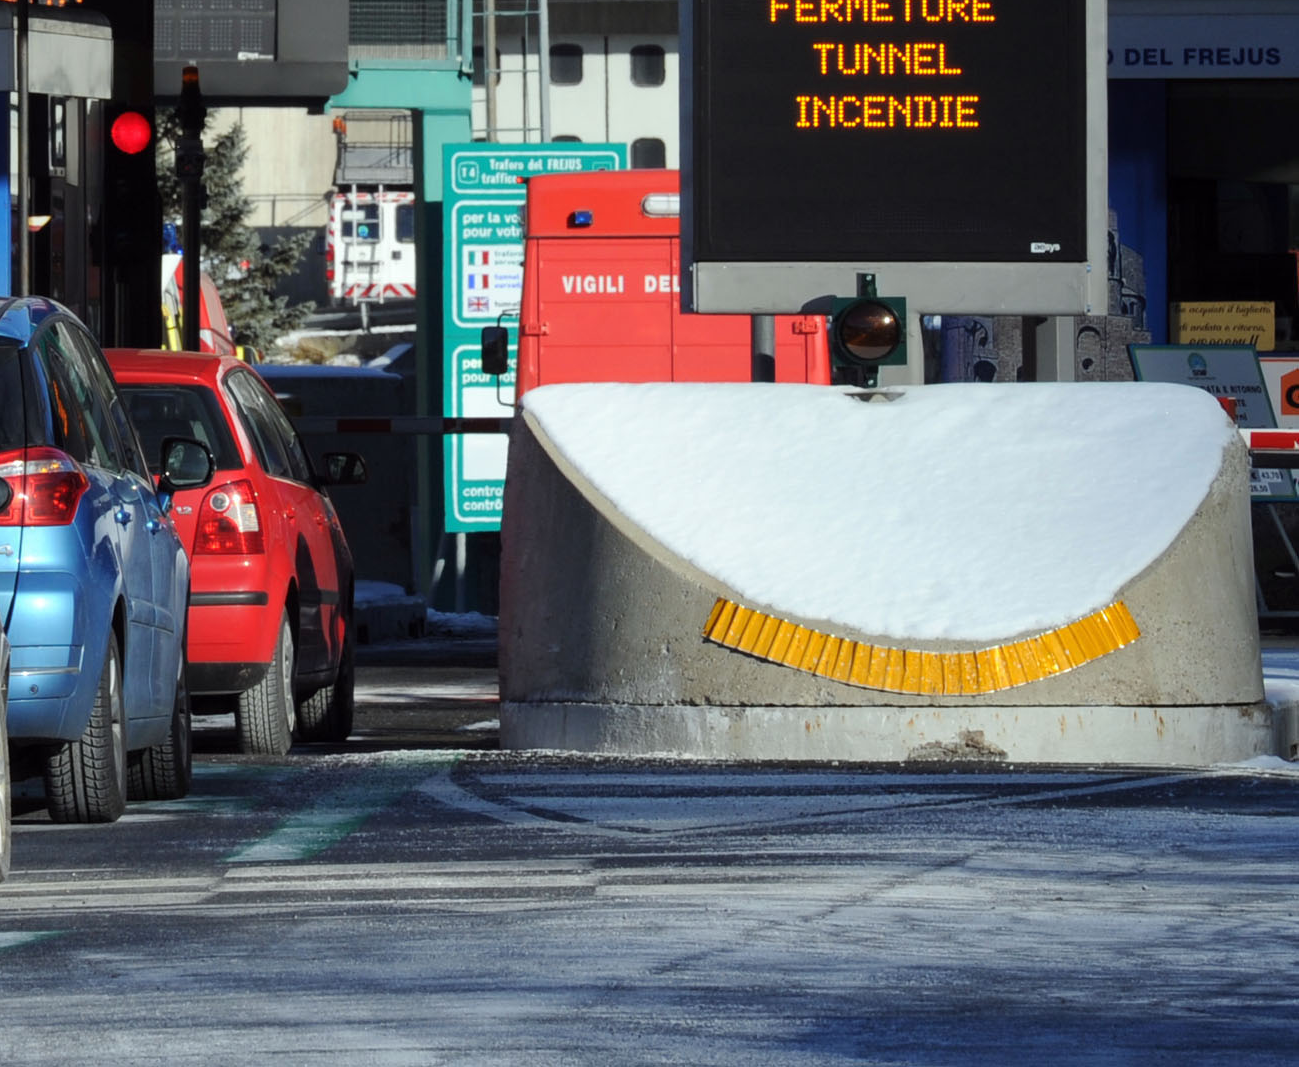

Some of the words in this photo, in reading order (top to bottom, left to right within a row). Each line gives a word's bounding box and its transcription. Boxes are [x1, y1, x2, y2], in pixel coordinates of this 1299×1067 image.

[813, 42, 962, 76] TUNNEL
[1125, 47, 1174, 66] DEL
[1183, 47, 1281, 66] FREJUS
[796, 94, 980, 129] INCENDIE
[489, 158, 524, 171] Traforo
[528, 158, 543, 170] del
[547, 158, 582, 170] FREJUS
[462, 213, 484, 225] per
[487, 212, 500, 224] la
[462, 228, 492, 240] pour
[562, 275, 625, 294] VIGILI
[462, 373, 491, 385] pour
